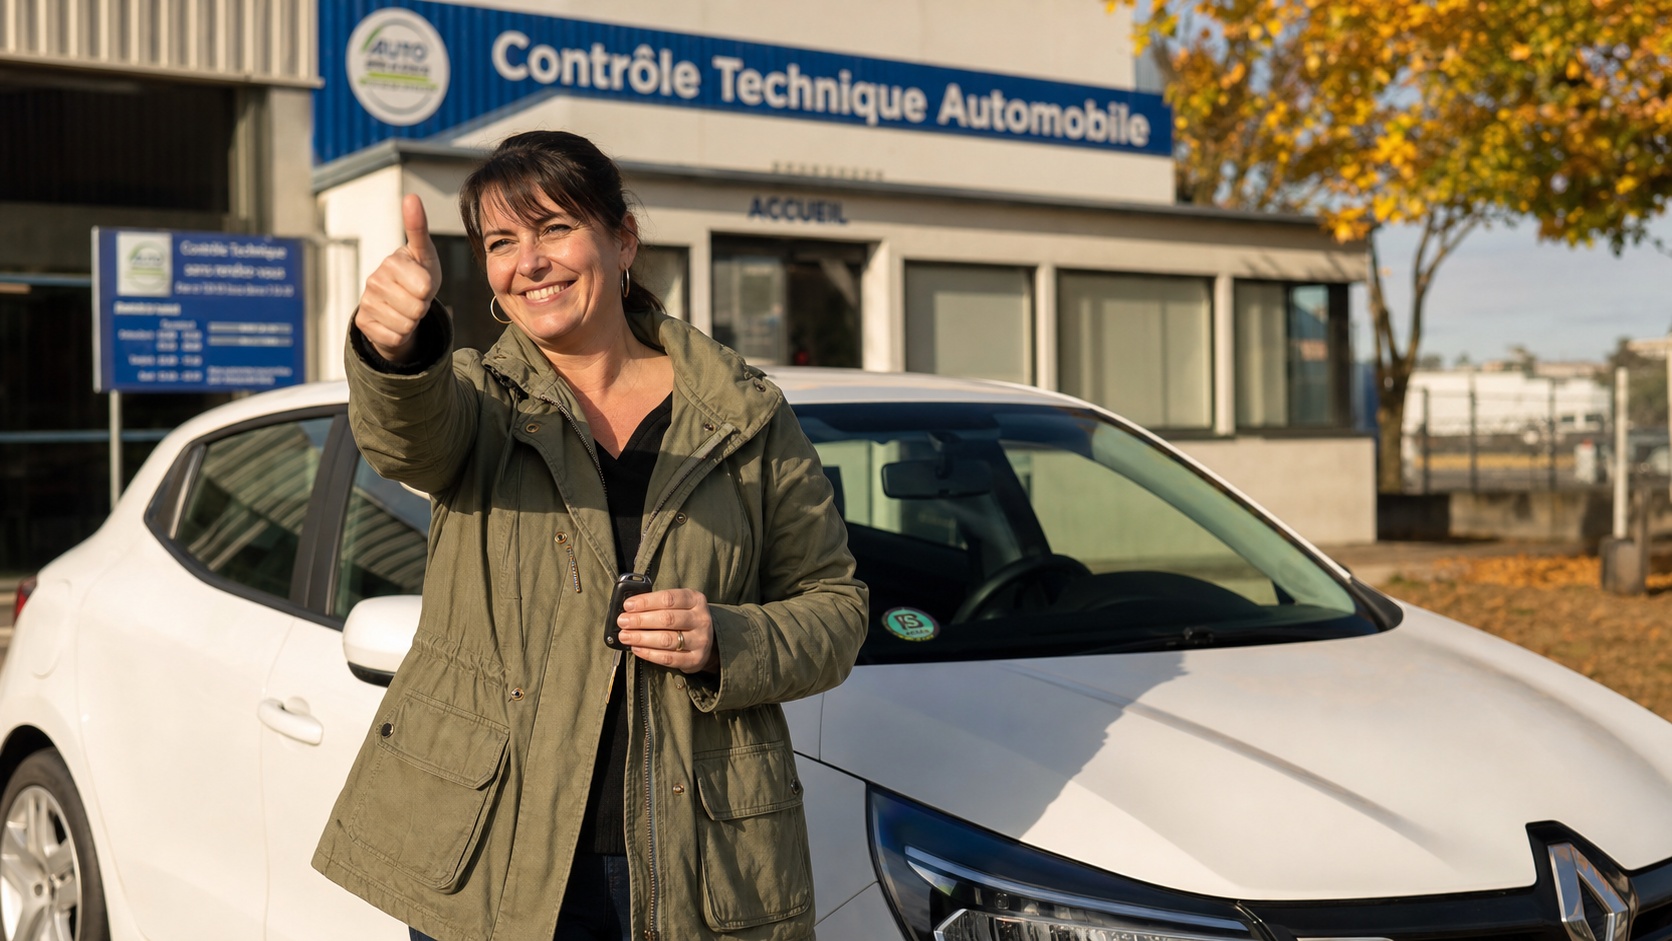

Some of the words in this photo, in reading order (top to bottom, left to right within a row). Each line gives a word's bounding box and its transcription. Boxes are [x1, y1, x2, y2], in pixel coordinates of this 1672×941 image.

[368, 40, 429, 62] AUTO
[492, 30, 701, 99] Contrôle
[713, 57, 928, 126] Technique
[938, 84, 1150, 147] Automobile
[748, 196, 849, 224] ACCUEIL
